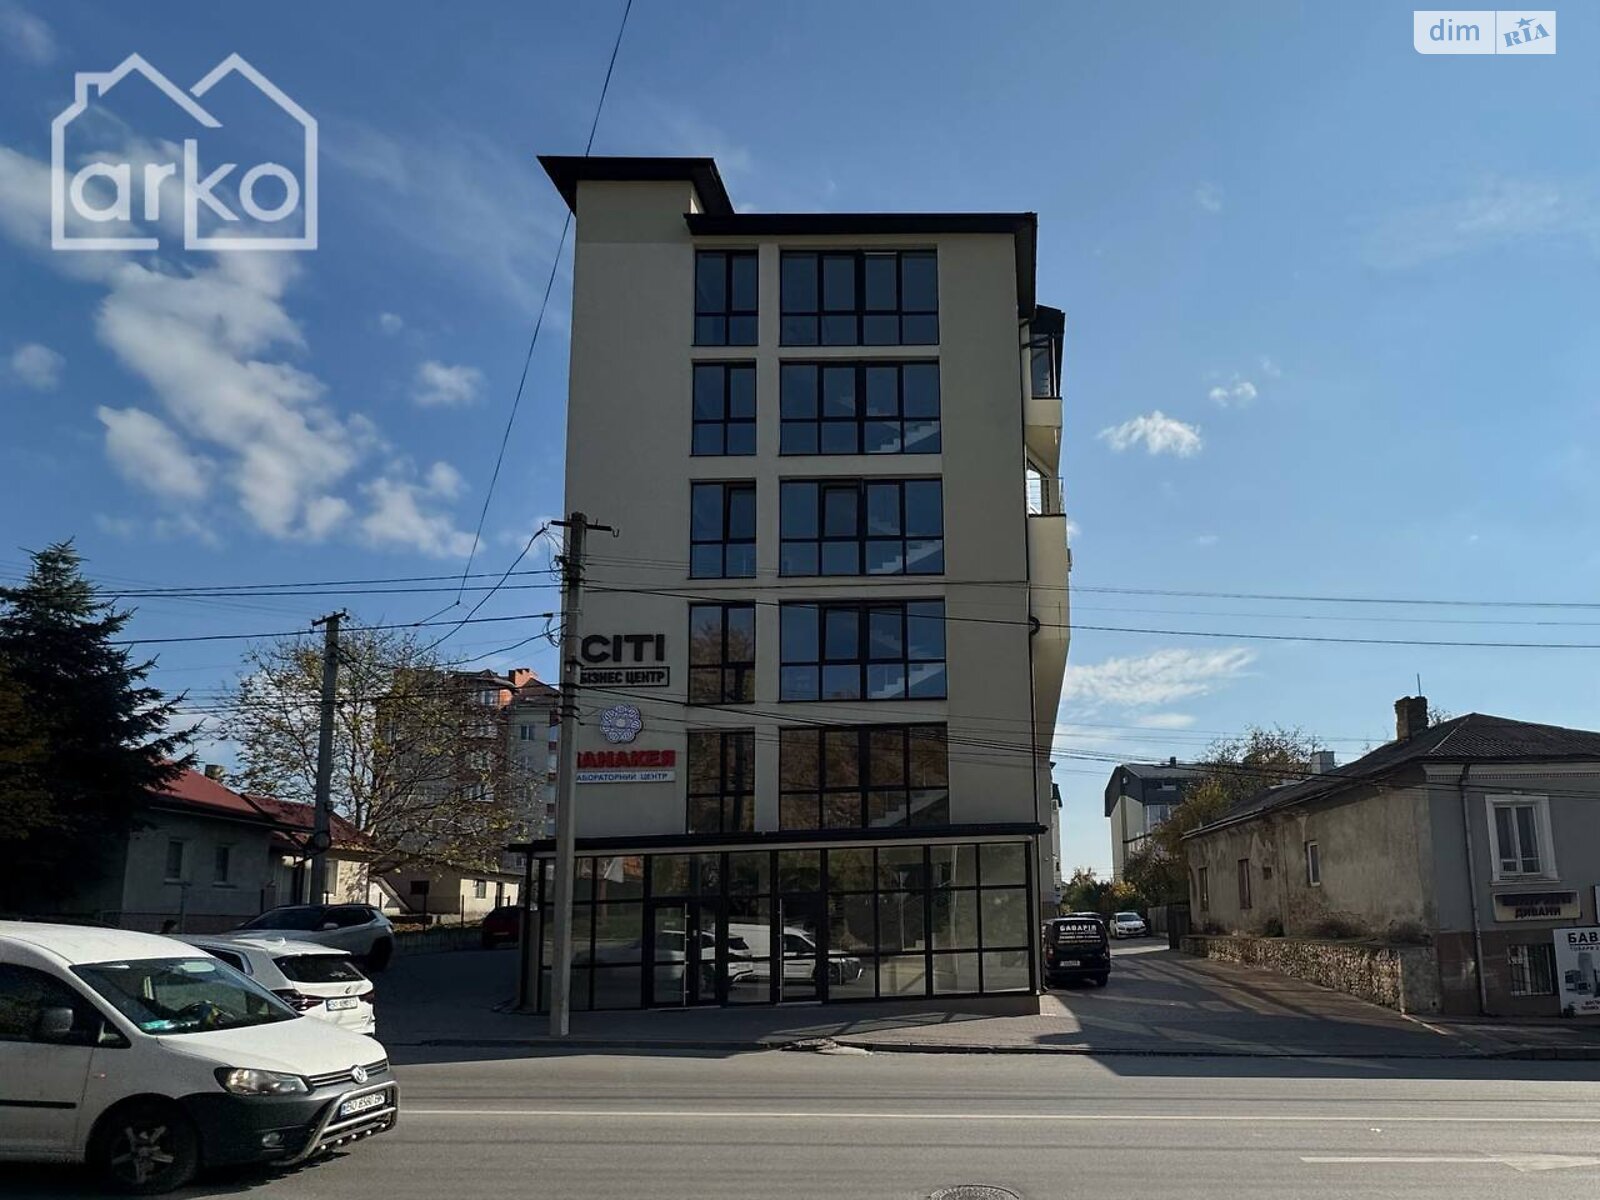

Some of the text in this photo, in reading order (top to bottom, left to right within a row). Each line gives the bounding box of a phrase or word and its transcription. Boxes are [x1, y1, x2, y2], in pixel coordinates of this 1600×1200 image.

[625, 670, 666, 683] ЦЕНТР
[640, 772, 668, 781] ЦЕНТР
[1515, 906, 1561, 919] ДИВАНИ
